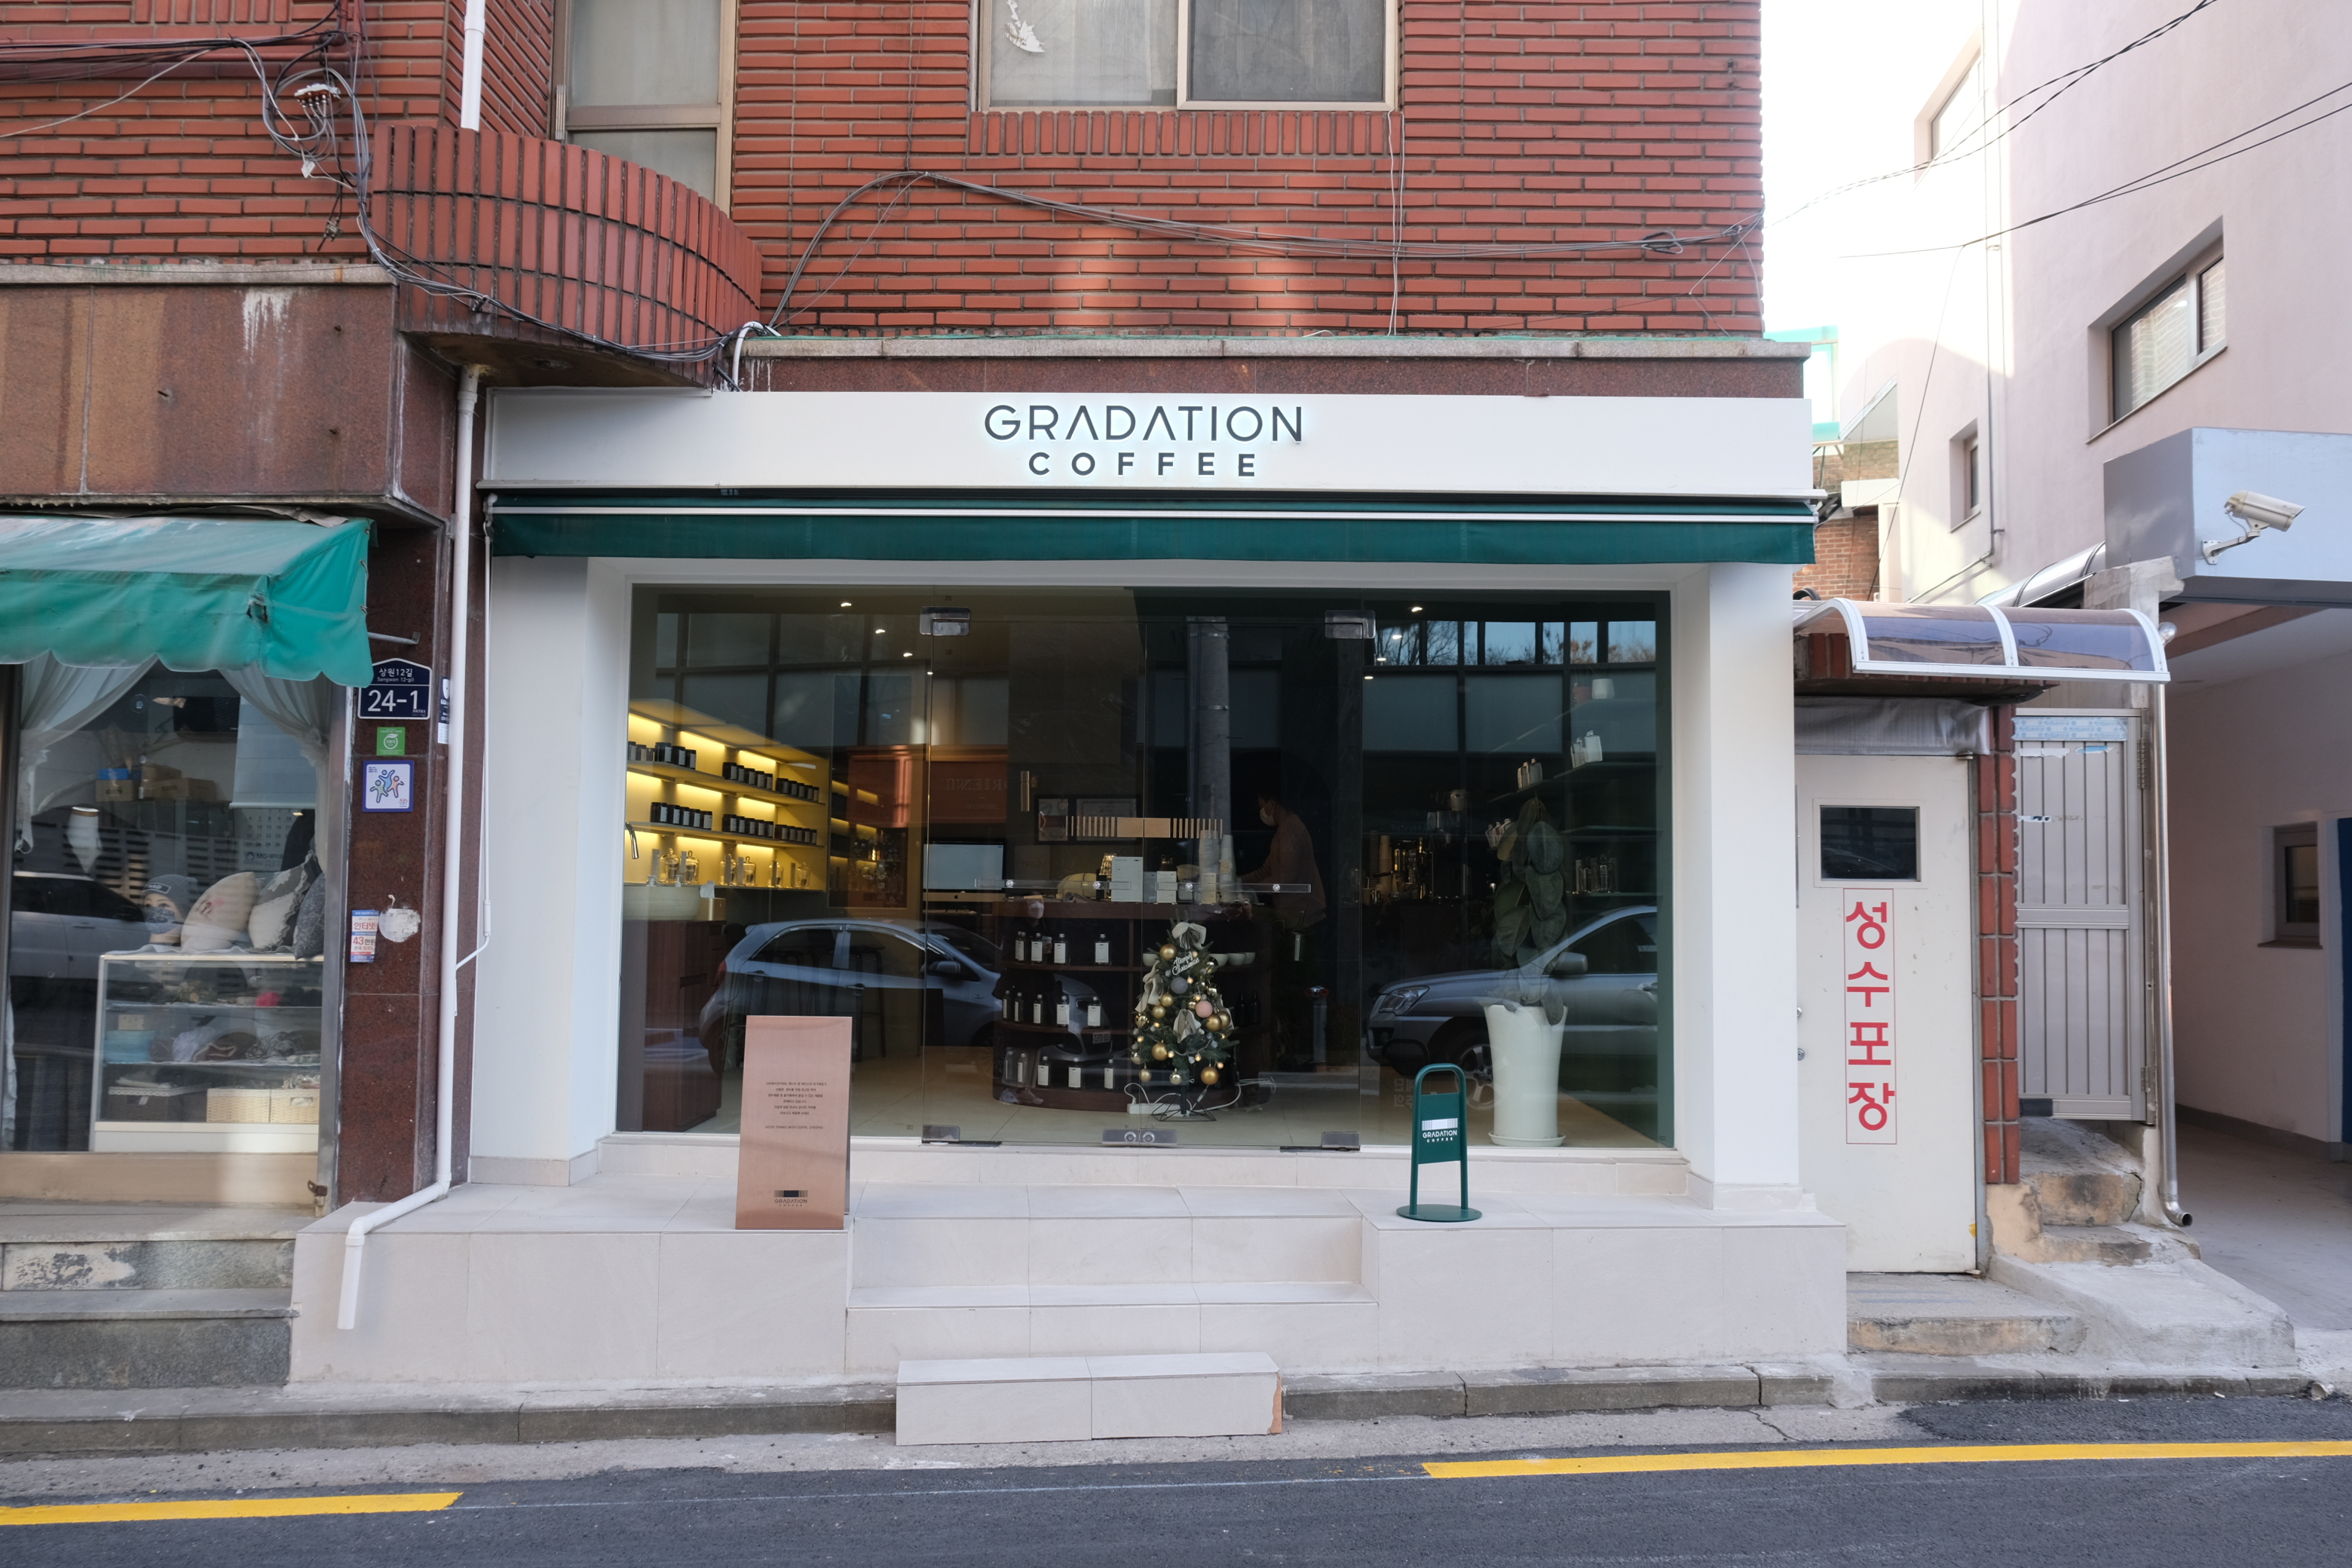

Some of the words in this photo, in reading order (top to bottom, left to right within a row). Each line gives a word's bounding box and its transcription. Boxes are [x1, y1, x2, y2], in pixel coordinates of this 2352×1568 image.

[985, 405, 1302, 442] GRADATION
[1028, 452, 1255, 477] COFFEE
[378, 668, 413, 677] 상원12길
[368, 690, 418, 712] 24-1
[1845, 902, 1895, 1131] 성수포장
[1423, 1130, 1457, 1138] GRADATION
